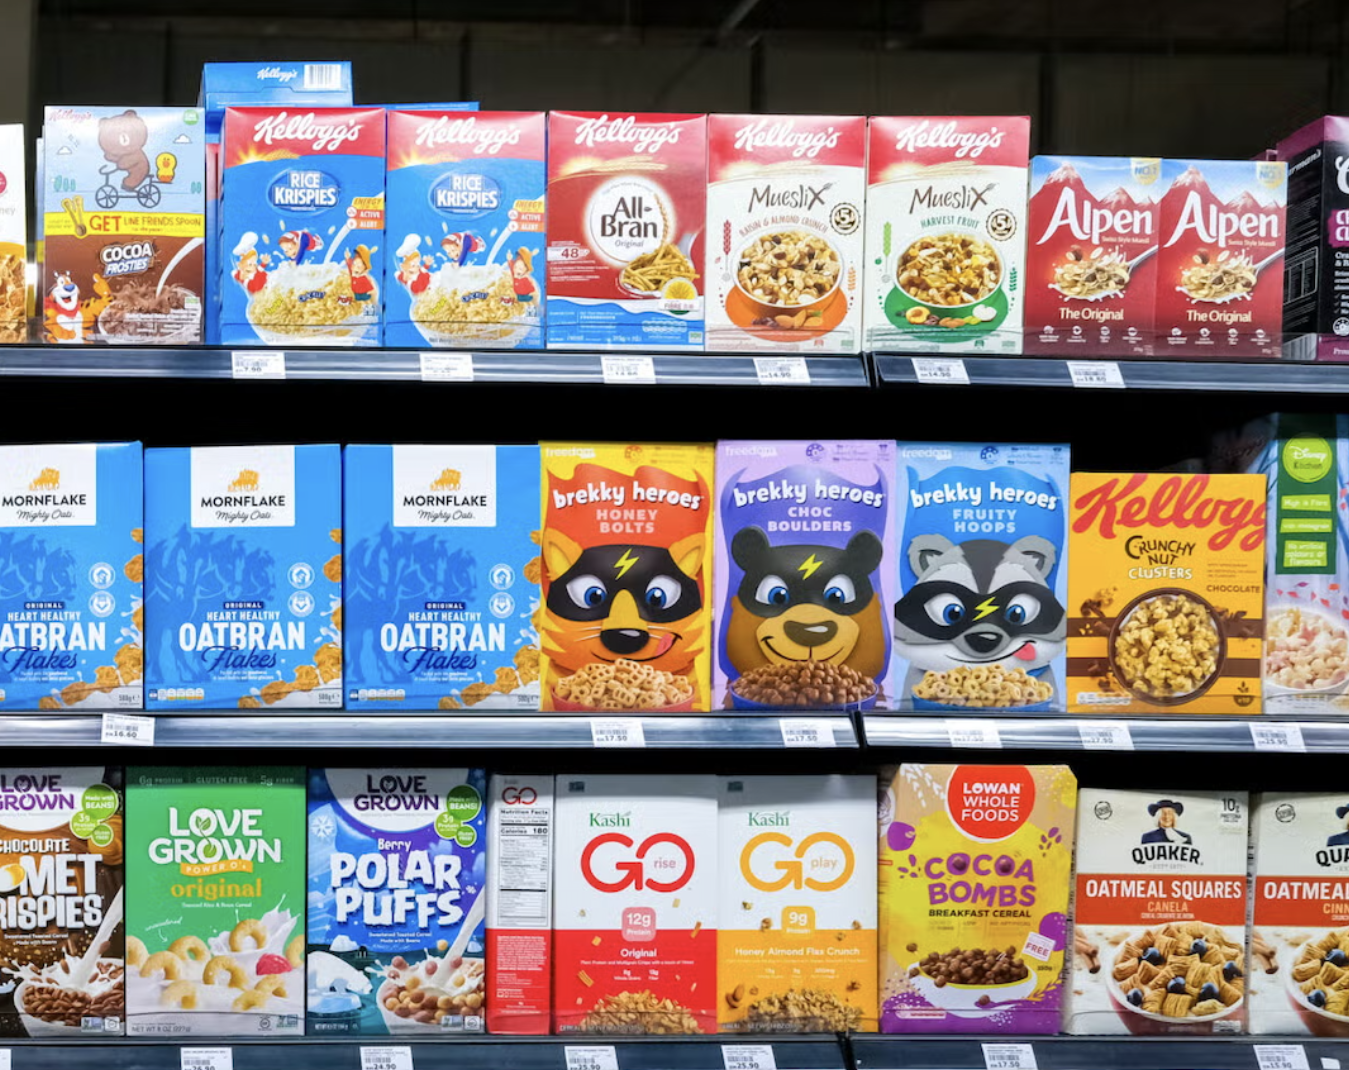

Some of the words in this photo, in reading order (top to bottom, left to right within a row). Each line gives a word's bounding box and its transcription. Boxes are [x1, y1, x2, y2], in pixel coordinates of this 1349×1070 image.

[253, 117, 359, 151] Kellogg's
[575, 116, 682, 152] Kellogg's
[290, 172, 320, 189] RICE
[273, 187, 336, 207] KRISPIES
[1036, 187, 1152, 245] Alpen
[600, 215, 657, 239] Bran
[99, 243, 152, 263] COCOA
[561, 248, 579, 259] 48
[1059, 308, 1079, 320] The
[1081, 308, 1124, 322] Original
[2, 494, 86, 506] MORNFLAKE
[553, 481, 625, 509] brekky
[632, 482, 701, 509] heroes
[733, 480, 805, 508] brekky
[815, 480, 883, 507] heroes
[911, 482, 983, 509] brekky
[990, 483, 1057, 509] heroes
[596, 509, 657, 521] HONEY
[788, 506, 832, 518] CHOC
[953, 509, 1017, 521] FRUITY
[600, 522, 654, 533] BOLTS
[768, 520, 852, 532] BOULDERS
[955, 521, 1016, 533] HOOPS
[1125, 535, 1196, 559] CRUNCHY
[1148, 554, 1178, 566] NUT
[1129, 567, 1192, 579] CLUSTERS
[1207, 585, 1261, 593] CHOCOLATE
[7, 612, 37, 621] HEART
[40, 610, 81, 621] HEALTHY
[2, 645, 78, 672] Flakes
[113, 730, 137, 739] 16.60
[0, 775, 61, 793] LOVE
[963, 782, 1020, 795] LOWAN
[963, 796, 1019, 808] WHOLE
[169, 808, 262, 836] LOVE
[589, 812, 631, 828] Kashi
[961, 809, 1019, 822] FOODS
[148, 837, 282, 863] GROWN
[377, 837, 411, 852] Berry
[1132, 845, 1200, 865] QUAKER
[330, 852, 461, 888] POLAR
[653, 857, 676, 869] rise
[811, 856, 837, 871] play
[924, 853, 1034, 881] COCOA
[170, 880, 262, 901] original
[928, 881, 1036, 907] BOMBS
[1085, 880, 1167, 897] OATMEAL
[1171, 881, 1241, 899] SQUARES
[336, 889, 463, 927] PUFFS
[928, 909, 989, 918] BREAKFAST
[993, 910, 1031, 918] CEREAL
[1148, 902, 1188, 912] CANELA
[626, 913, 651, 927] 12g
[789, 911, 807, 926] 9g
[620, 948, 657, 958] Original
